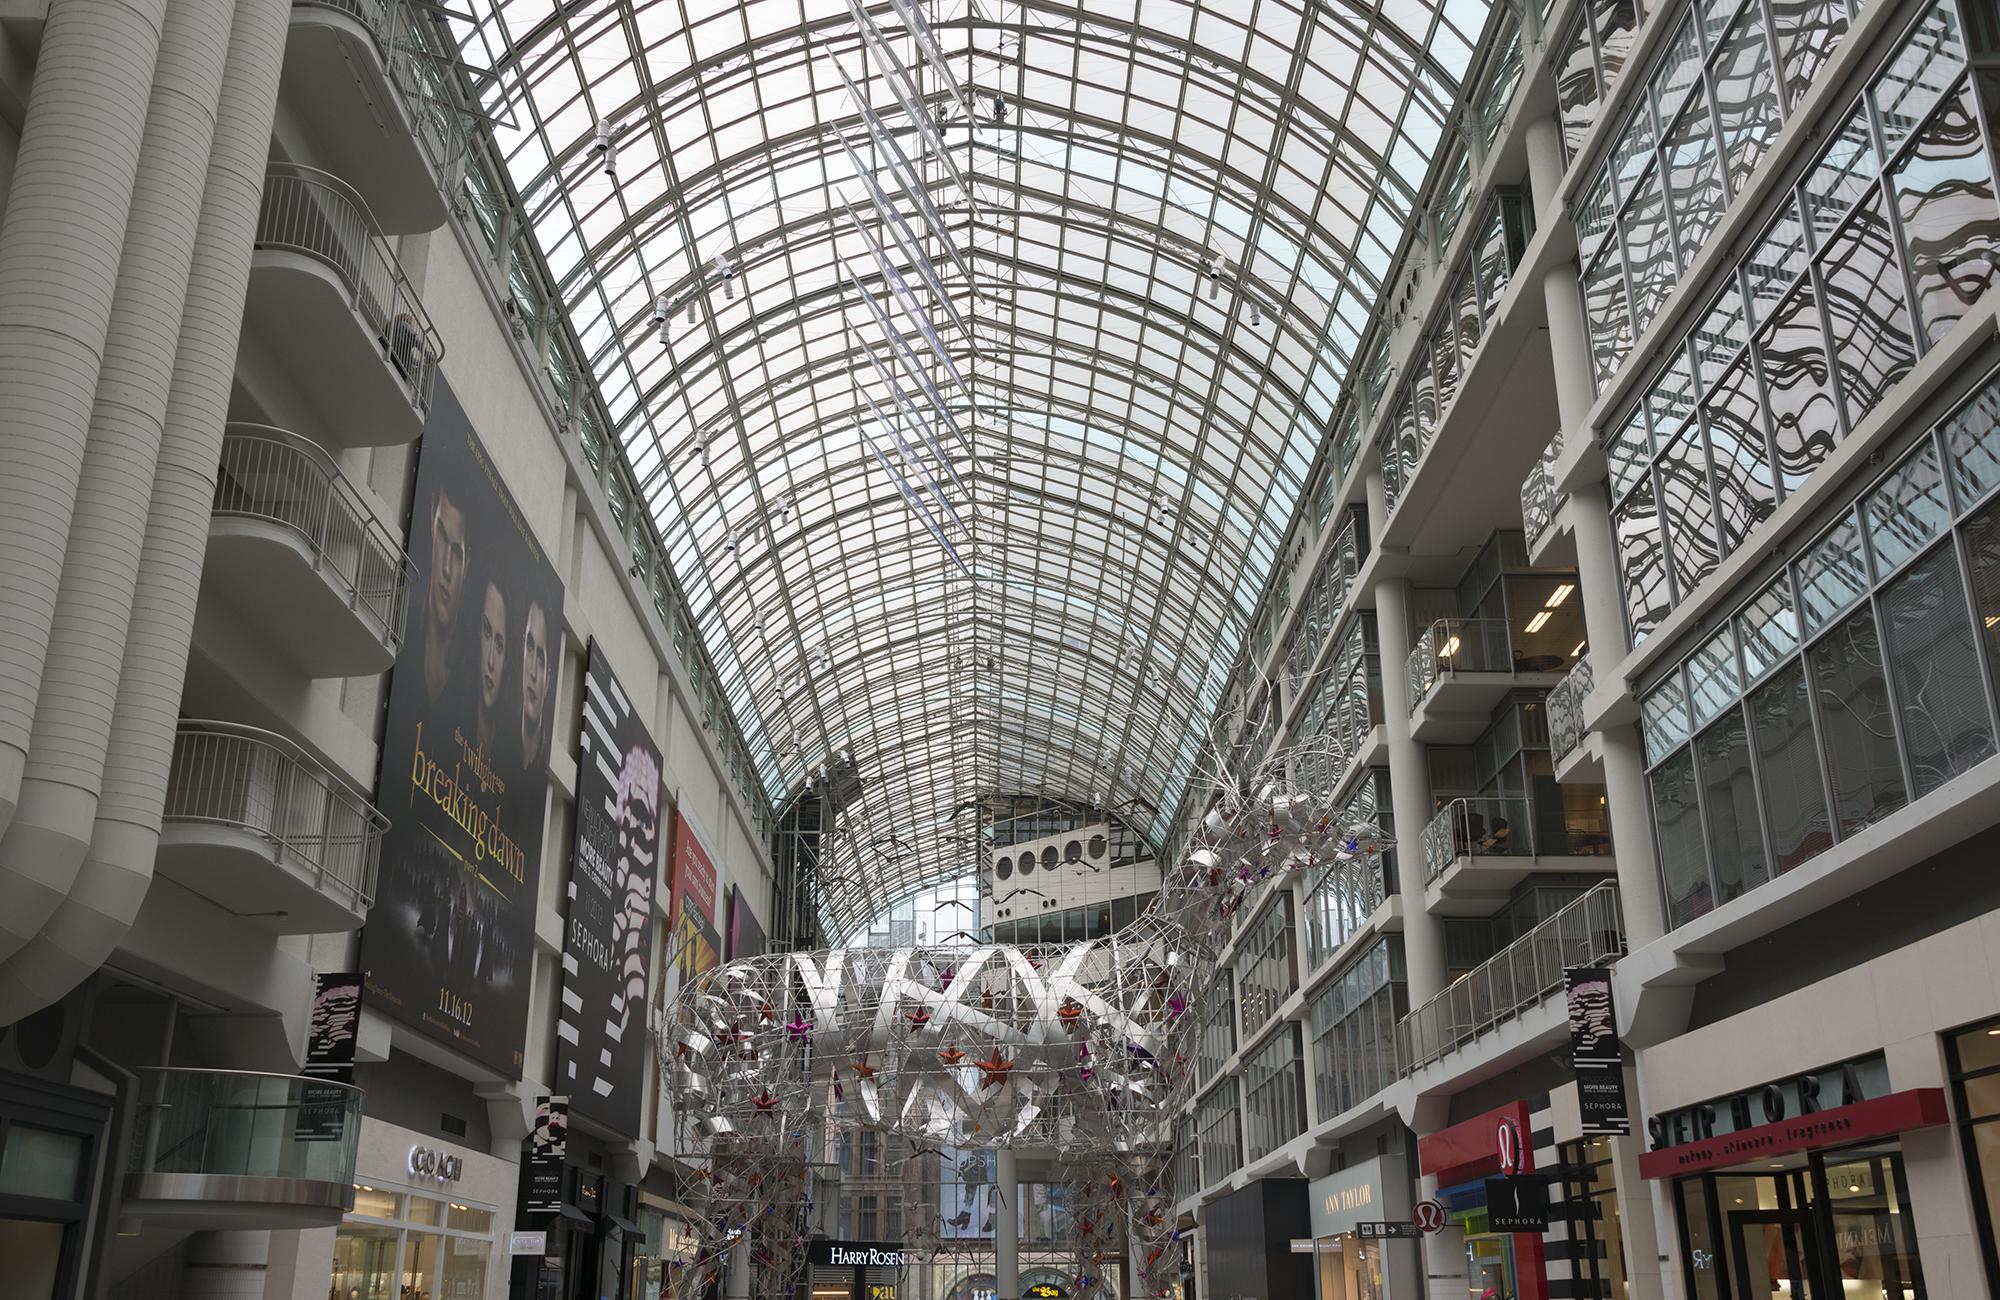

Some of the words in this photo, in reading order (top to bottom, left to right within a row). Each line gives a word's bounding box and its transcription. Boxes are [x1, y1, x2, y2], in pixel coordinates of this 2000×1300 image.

[454, 726, 464, 747] the
[462, 739, 495, 793] twilight
[410, 720, 489, 861] breaking
[488, 804, 525, 885] dawn
[463, 859, 474, 876] part
[580, 834, 596, 870] MORE
[595, 852, 614, 888] BEAUTY
[571, 917, 609, 973] SEPHORA
[438, 986, 474, 1027] 11.16.12
[304, 1106, 338, 1115] SEPHORA
[1584, 1102, 1622, 1110] SEPHORA
[1648, 1063, 1865, 1152] SEPHORA
[1678, 1149, 1713, 1166] makeup
[1723, 1133, 1774, 1155] skincare
[1786, 1116, 1851, 1141] fragrance
[410, 1145, 464, 1182] COACH
[1325, 1193, 1340, 1216] ANN
[1340, 1184, 1372, 1211] TAYLOR
[1495, 1217, 1542, 1225] SEPHORA
[831, 1247, 869, 1265] HARRY
[869, 1248, 904, 1266] ROSEN
[1040, 1285, 1059, 1298] Bay
